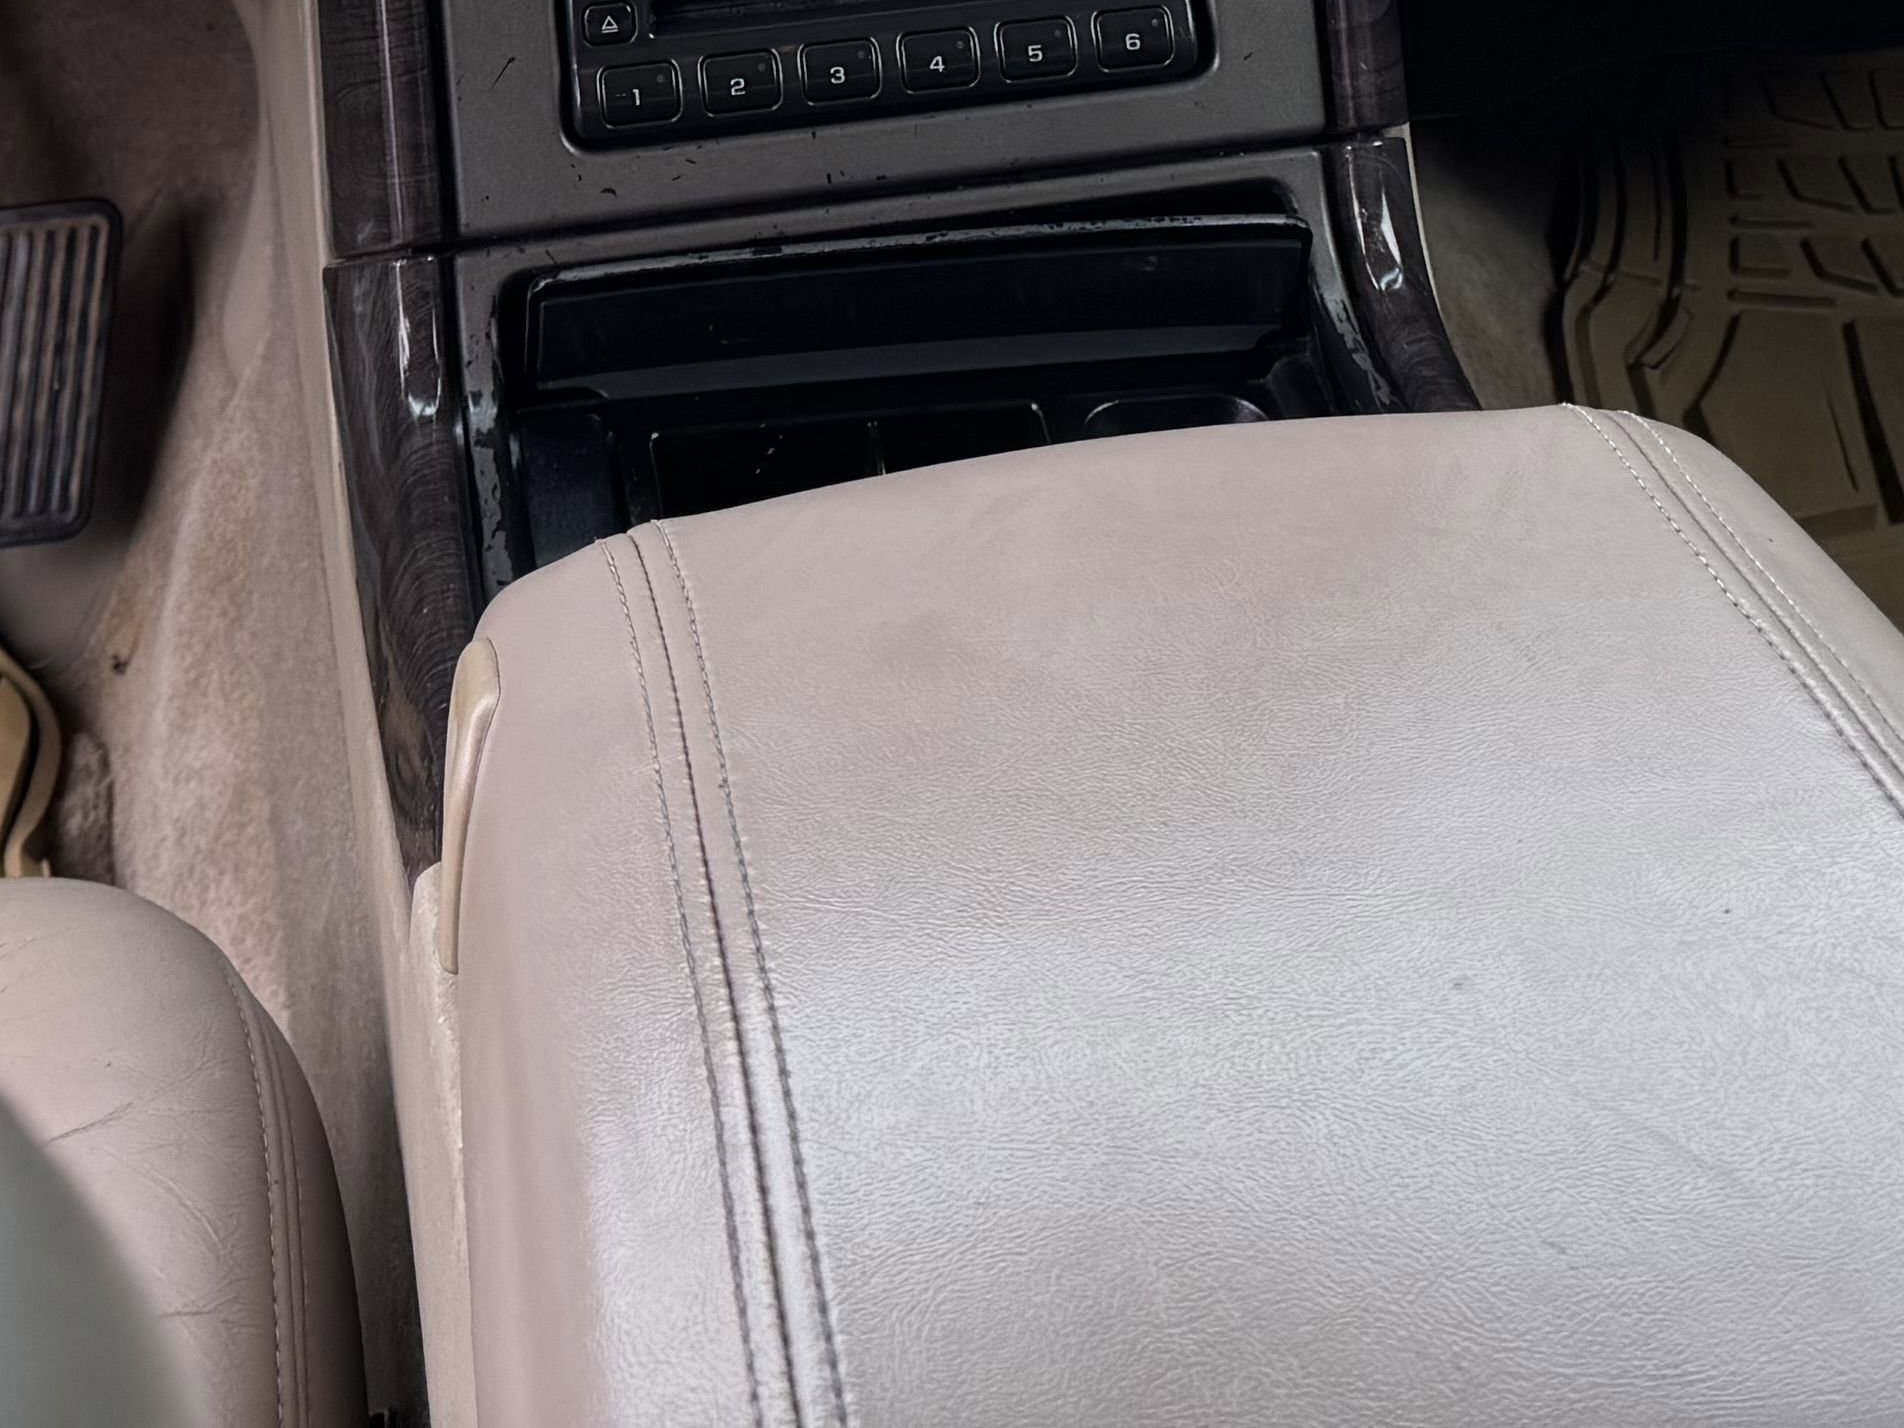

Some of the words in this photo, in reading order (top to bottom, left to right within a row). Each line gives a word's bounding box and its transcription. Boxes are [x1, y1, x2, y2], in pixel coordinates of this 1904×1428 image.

[1125, 33, 1141, 51] 6
[1027, 44, 1044, 62] 5
[929, 55, 945, 73] 4
[830, 66, 845, 84] 3
[730, 78, 746, 96] 2
[632, 88, 641, 106] 1
